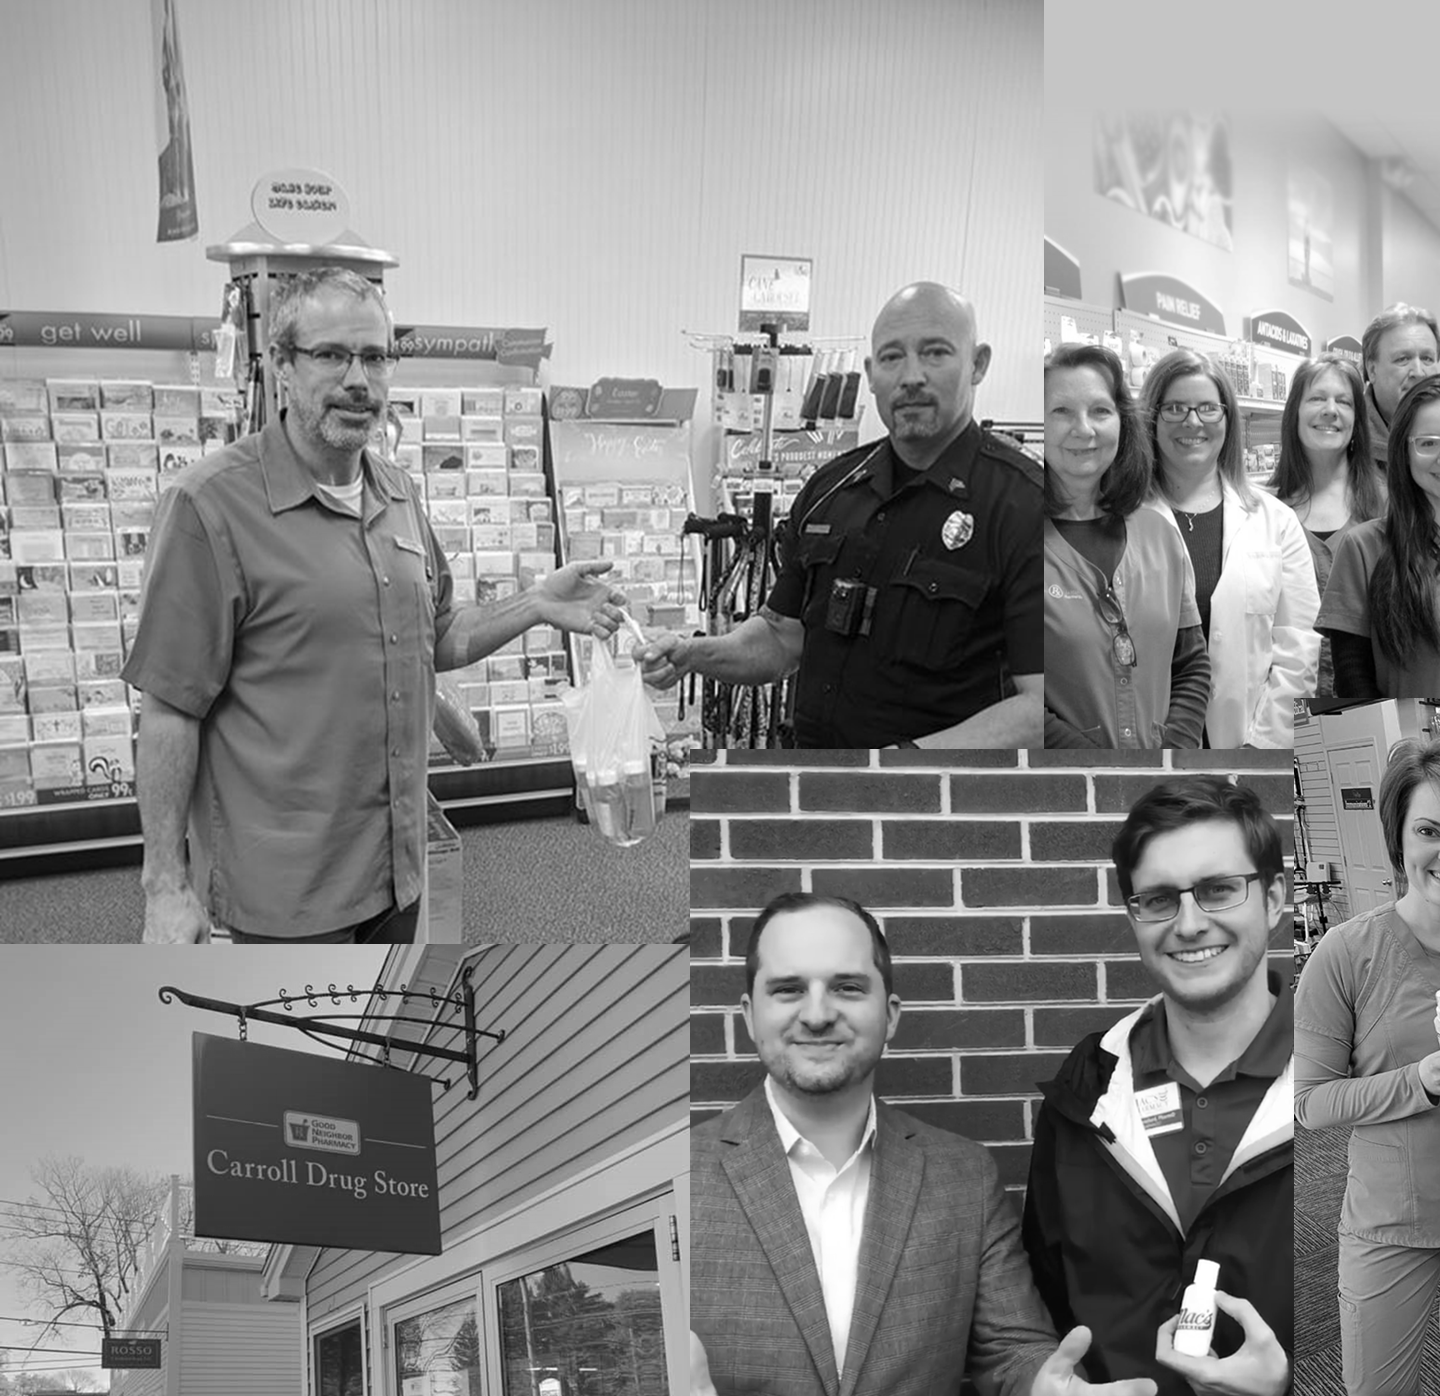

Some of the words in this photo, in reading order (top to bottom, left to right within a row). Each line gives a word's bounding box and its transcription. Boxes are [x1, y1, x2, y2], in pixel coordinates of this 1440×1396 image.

[1156, 291, 1175, 313] PAIN
[1176, 297, 1201, 320] RELIEF
[41, 322, 81, 344] get
[91, 319, 141, 341] well
[1257, 320, 1282, 341] ANTACIDS
[1286, 329, 1309, 350] LAXATIVES
[53, 787, 86, 797] WRAPPED
[87, 784, 110, 795] CARDS
[88, 791, 109, 800] ONLY
[311, 1119, 336, 1131] GOOD
[311, 1127, 354, 1142] NEIGHBOR
[312, 1136, 357, 1149] PHARMACY
[207, 1149, 298, 1185] Carroll
[306, 1161, 367, 1200] Drug
[374, 1170, 430, 1198] Store
[111, 1345, 152, 1356] ROSSO
